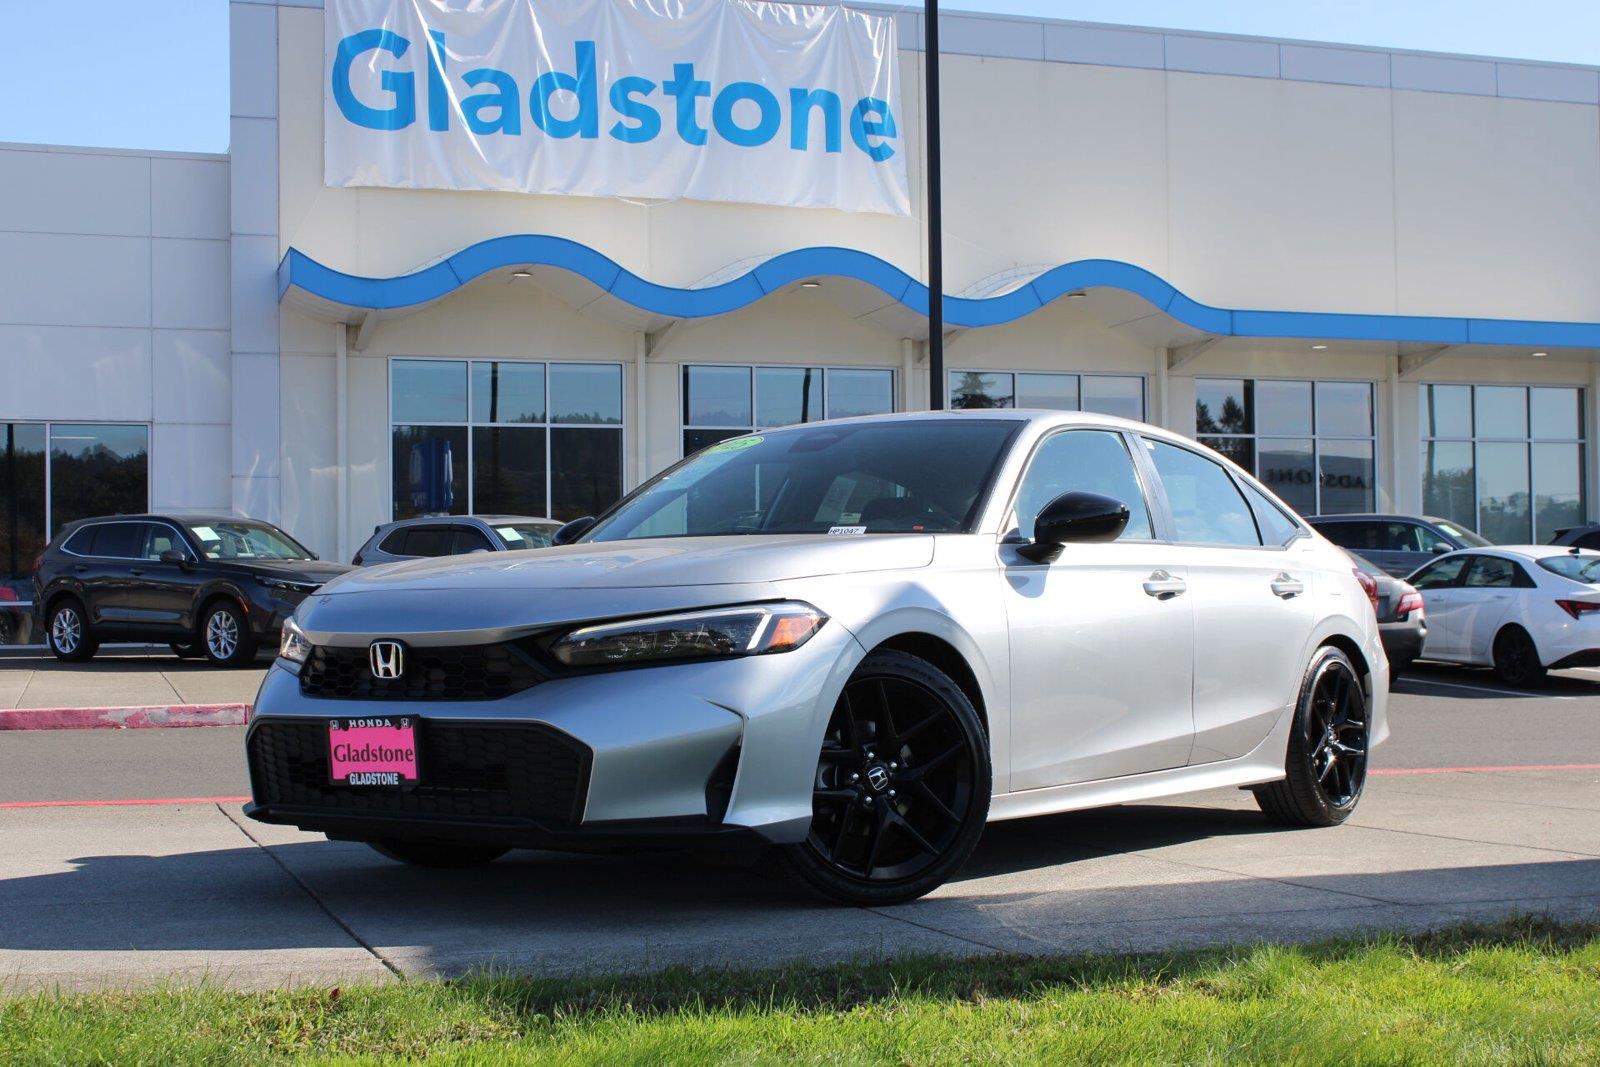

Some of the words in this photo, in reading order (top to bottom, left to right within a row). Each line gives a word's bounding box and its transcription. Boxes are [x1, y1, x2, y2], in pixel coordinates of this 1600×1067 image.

[332, 28, 897, 162] Gladstone
[349, 719, 392, 728] HONDA
[333, 743, 414, 762] Gladstone
[349, 773, 399, 785] GLADSTONE
